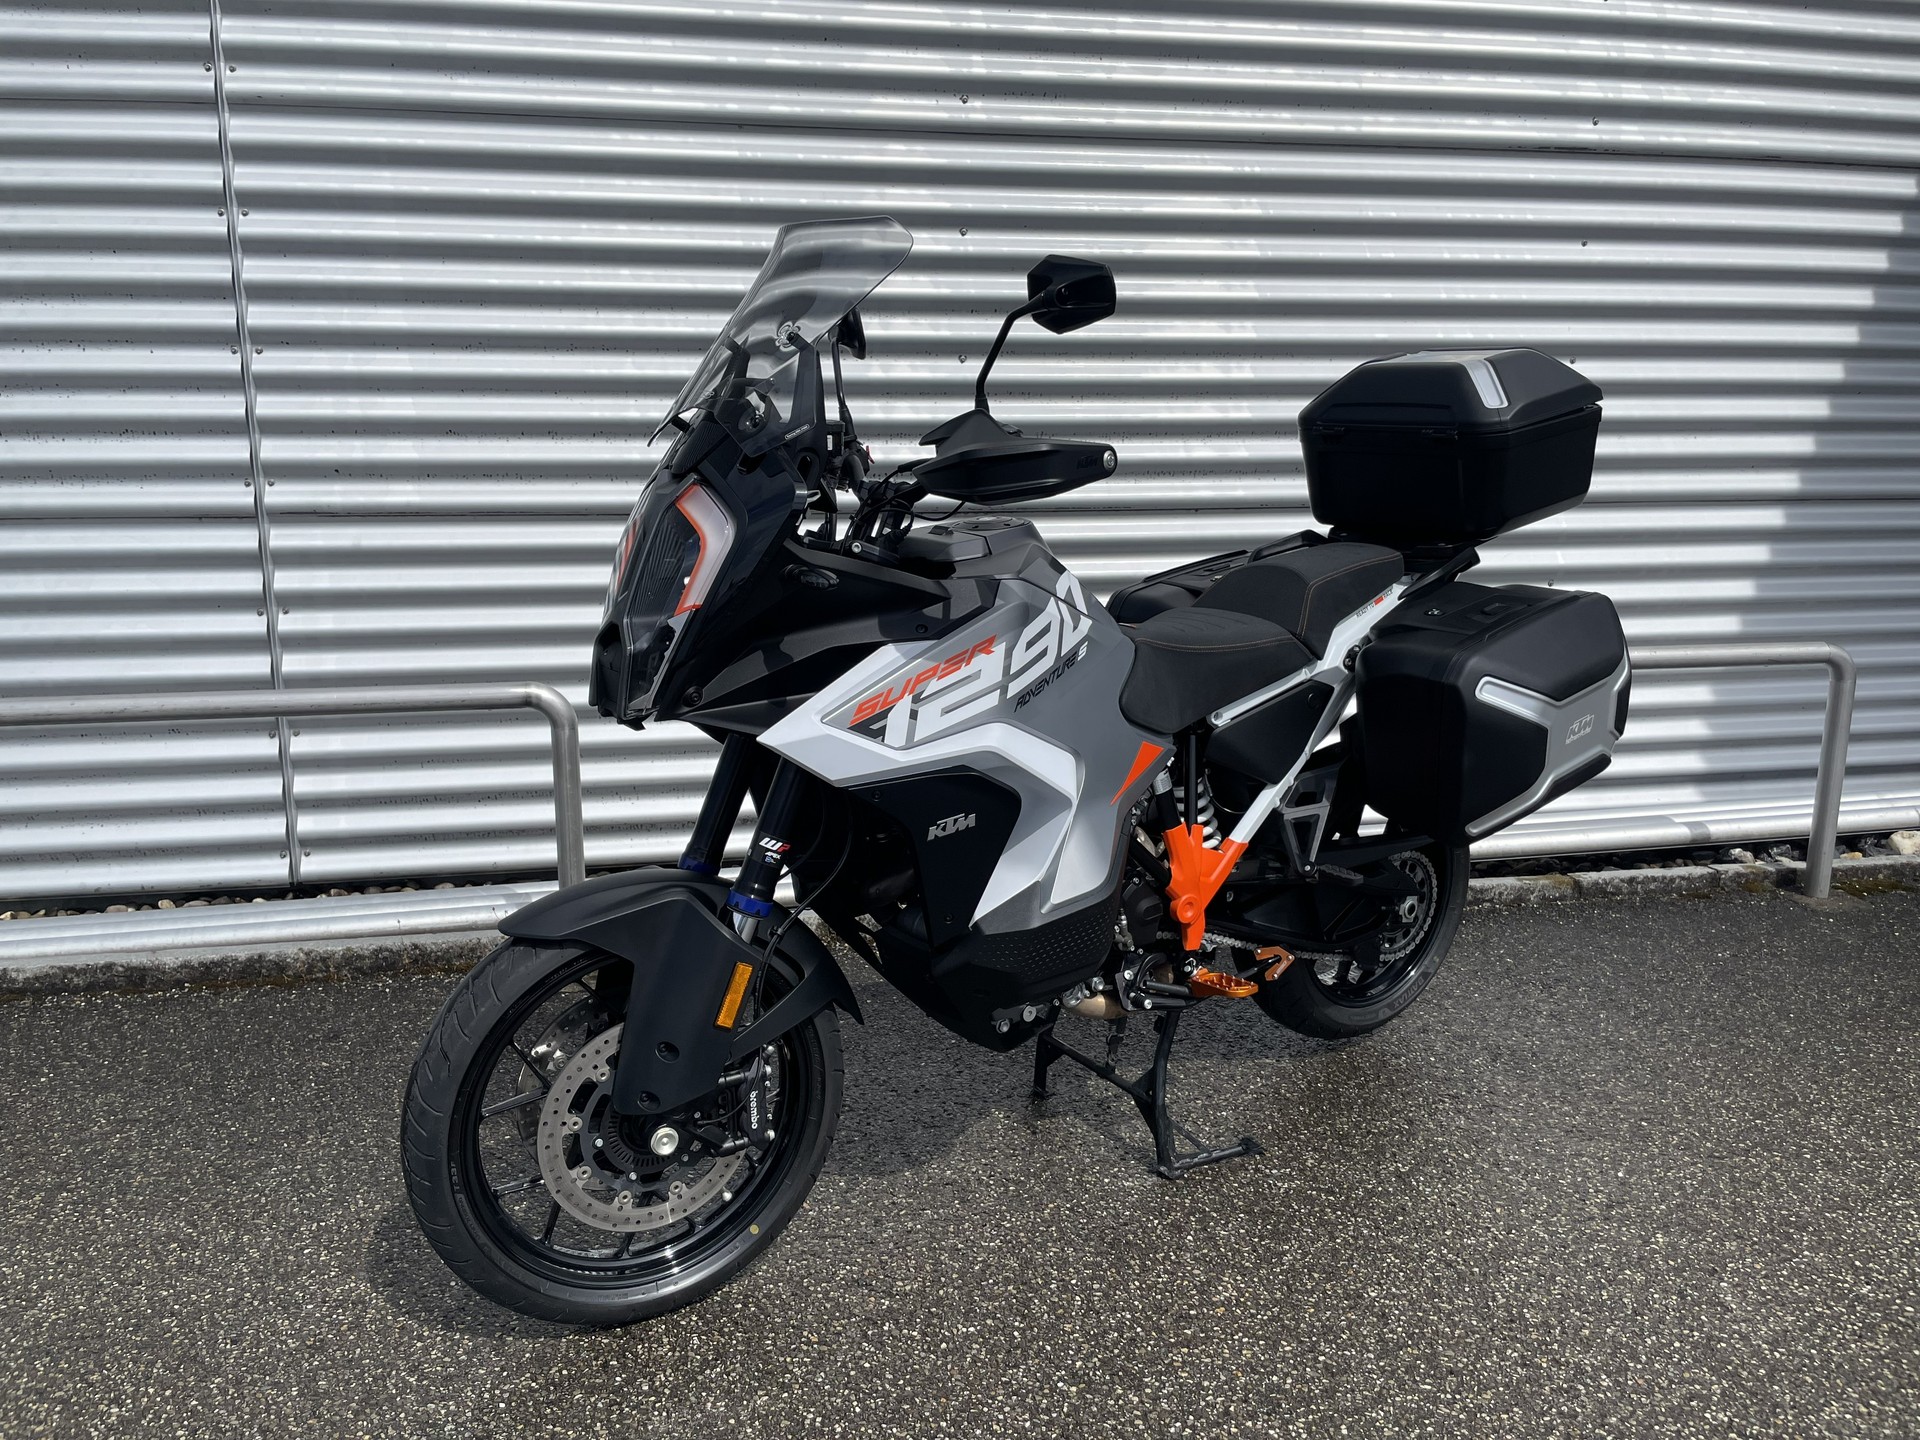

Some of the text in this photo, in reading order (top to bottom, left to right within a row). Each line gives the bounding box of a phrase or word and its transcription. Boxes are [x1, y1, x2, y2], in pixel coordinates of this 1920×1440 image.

[884, 569, 1093, 748] 1290
[1013, 640, 1089, 714] ADVENTURE S
[848, 633, 998, 726] SUPER
[1565, 713, 1595, 745] KTM
[758, 836, 791, 853] WP
[926, 812, 976, 842] KTM
[749, 1089, 760, 1130] brembo
